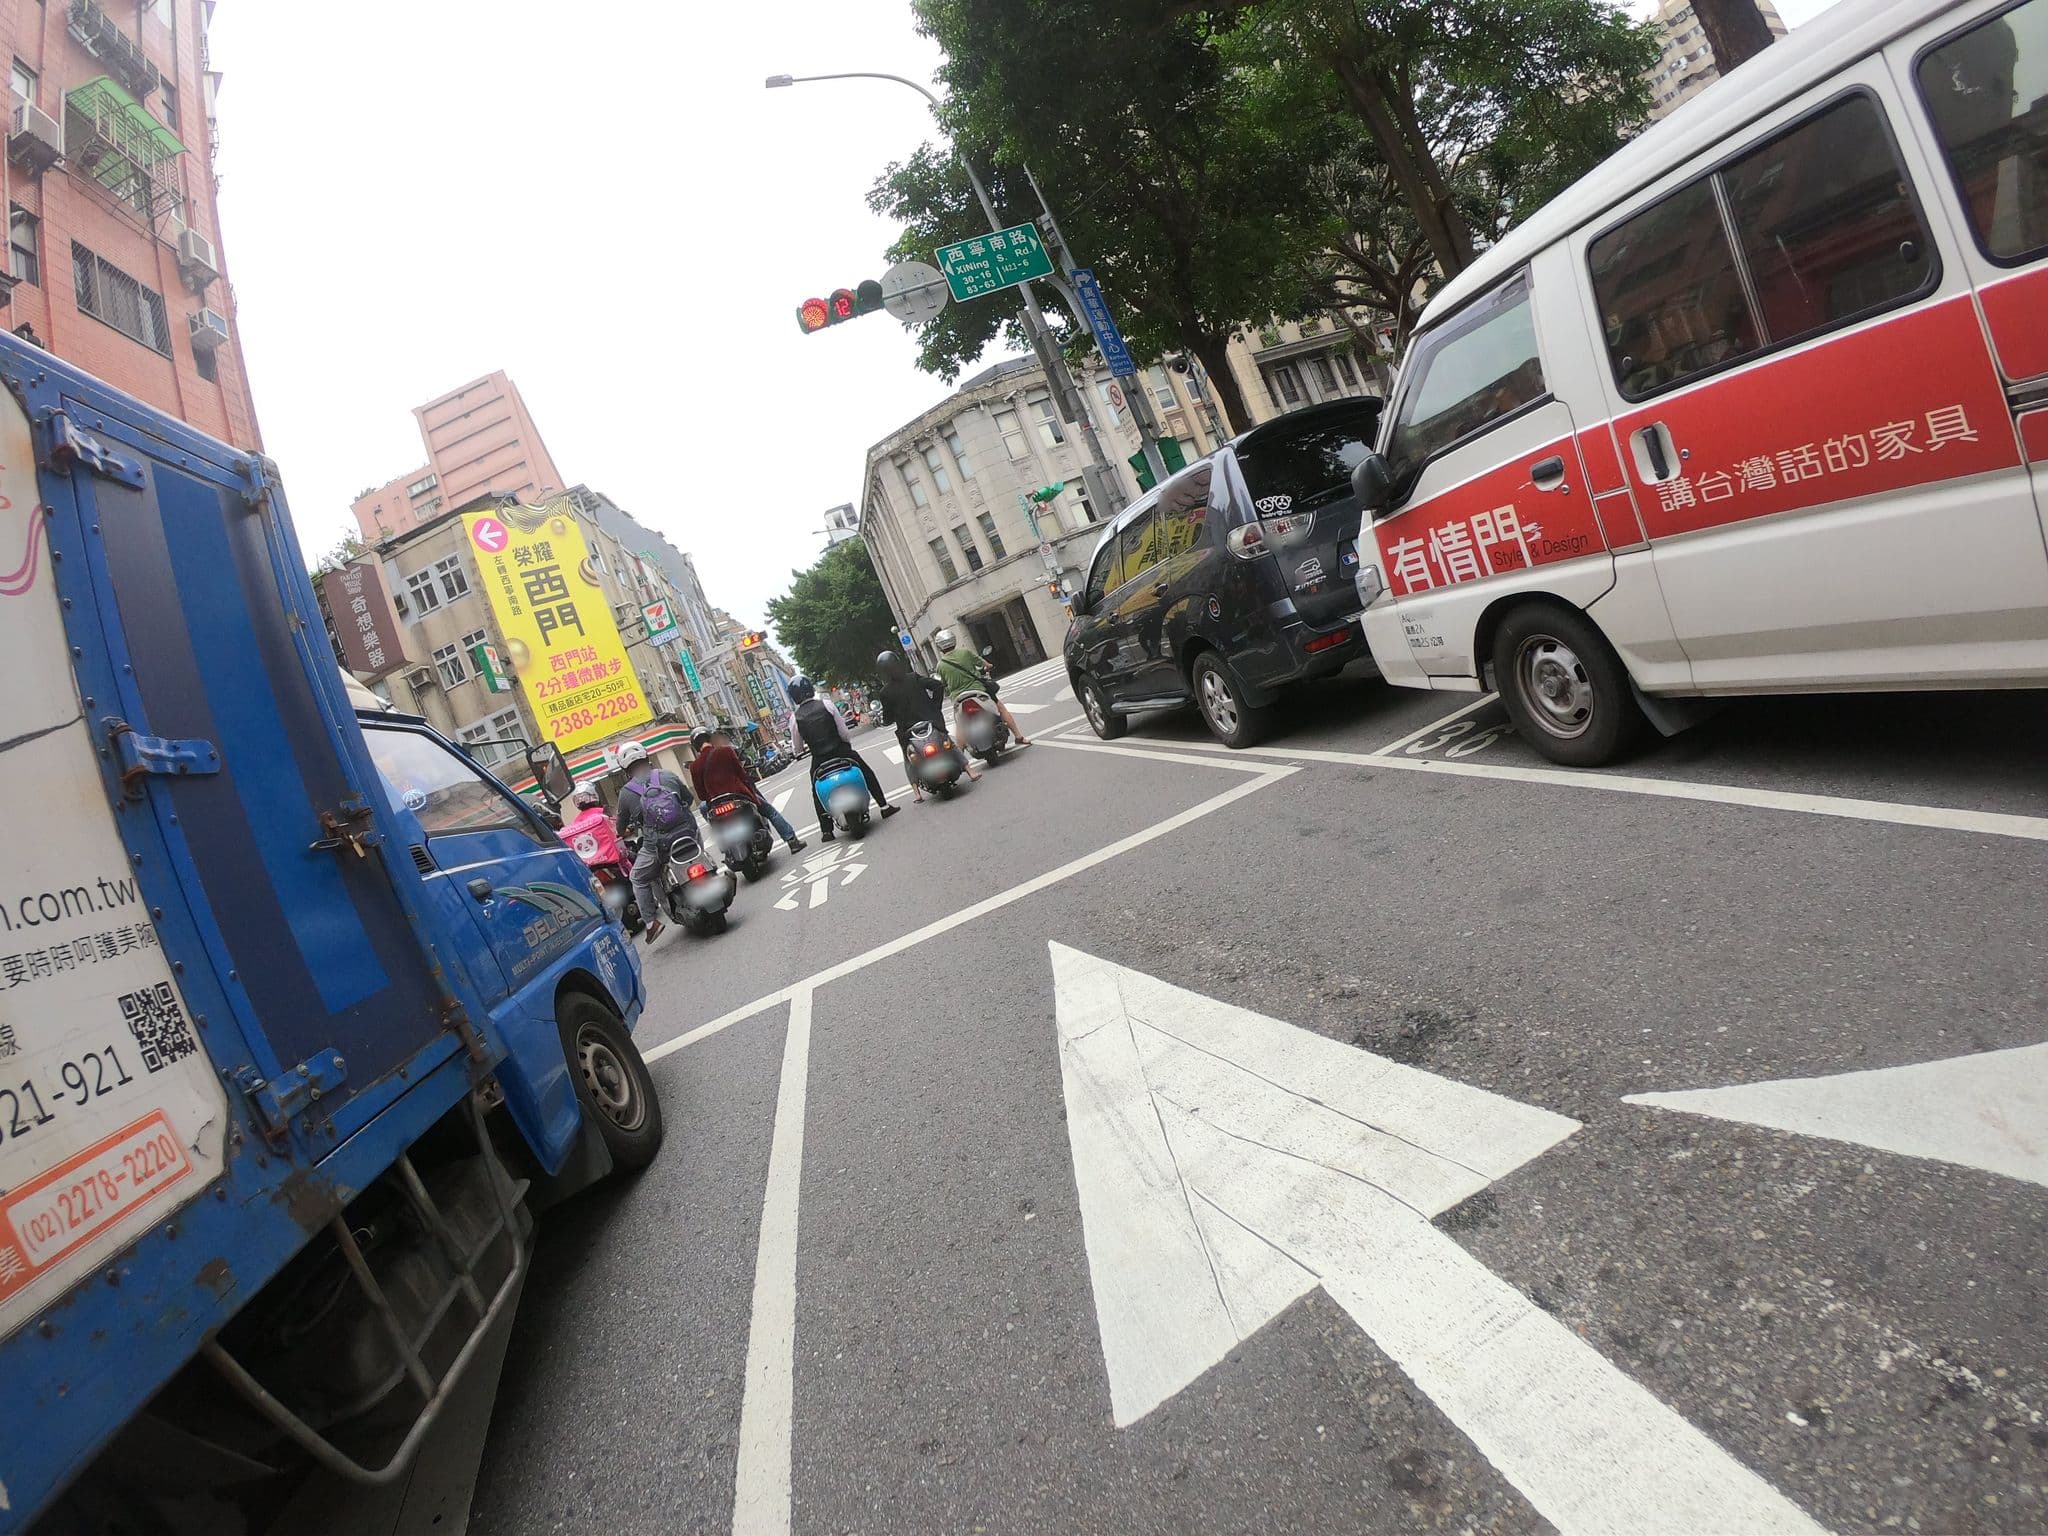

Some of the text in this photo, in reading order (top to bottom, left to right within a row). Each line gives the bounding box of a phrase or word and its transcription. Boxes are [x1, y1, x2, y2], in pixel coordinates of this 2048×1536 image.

[946, 230, 1026, 263] 西寧南路
[996, 254, 1008, 263] S.
[1015, 246, 1032, 257] Rd.
[963, 270, 991, 285] 30-16
[967, 279, 996, 294] 83-63
[1656, 404, 1978, 513] 講台灣話的家具
[512, 541, 555, 567] 榮耀
[1387, 504, 1533, 594] 有情門
[1494, 550, 1525, 567] Style
[1544, 534, 1589, 556] Design
[520, 564, 585, 646] 西門
[351, 595, 385, 669] 奇想樂器
[536, 657, 622, 698] 2分鐘微散步
[549, 645, 598, 673] 西門站
[550, 693, 638, 738] 2388-2288
[522, 906, 576, 948] DELICA
[0, 922, 158, 990] 要時時呵護美胸
[0, 1045, 134, 1145] 21-921
[22, 1134, 177, 1253] (02)2278-2220
